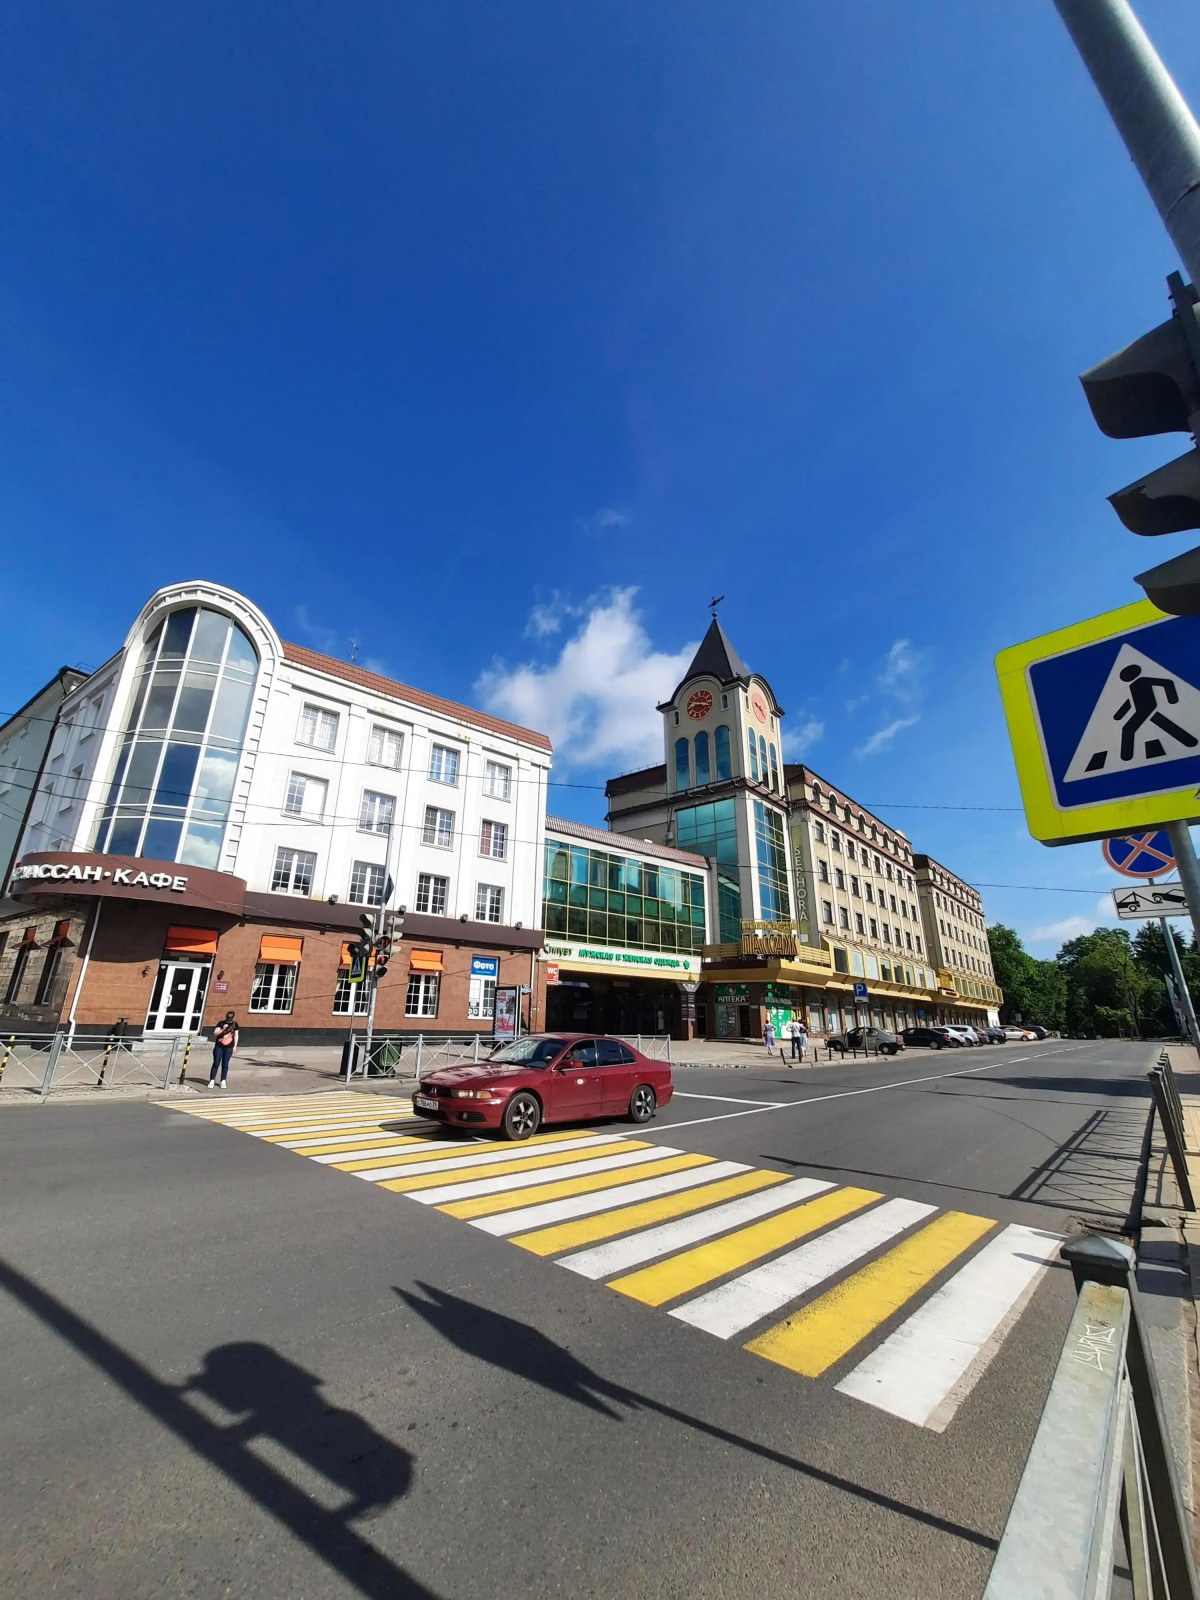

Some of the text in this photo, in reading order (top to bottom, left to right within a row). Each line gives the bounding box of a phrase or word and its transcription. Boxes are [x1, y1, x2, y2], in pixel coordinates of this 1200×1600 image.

[113, 868, 189, 891] КАФЕ
[794, 845, 808, 921] SEPHORA
[742, 933, 798, 955] ПАССАЖ
[547, 967, 559, 975] WC
[855, 985, 863, 995] P
